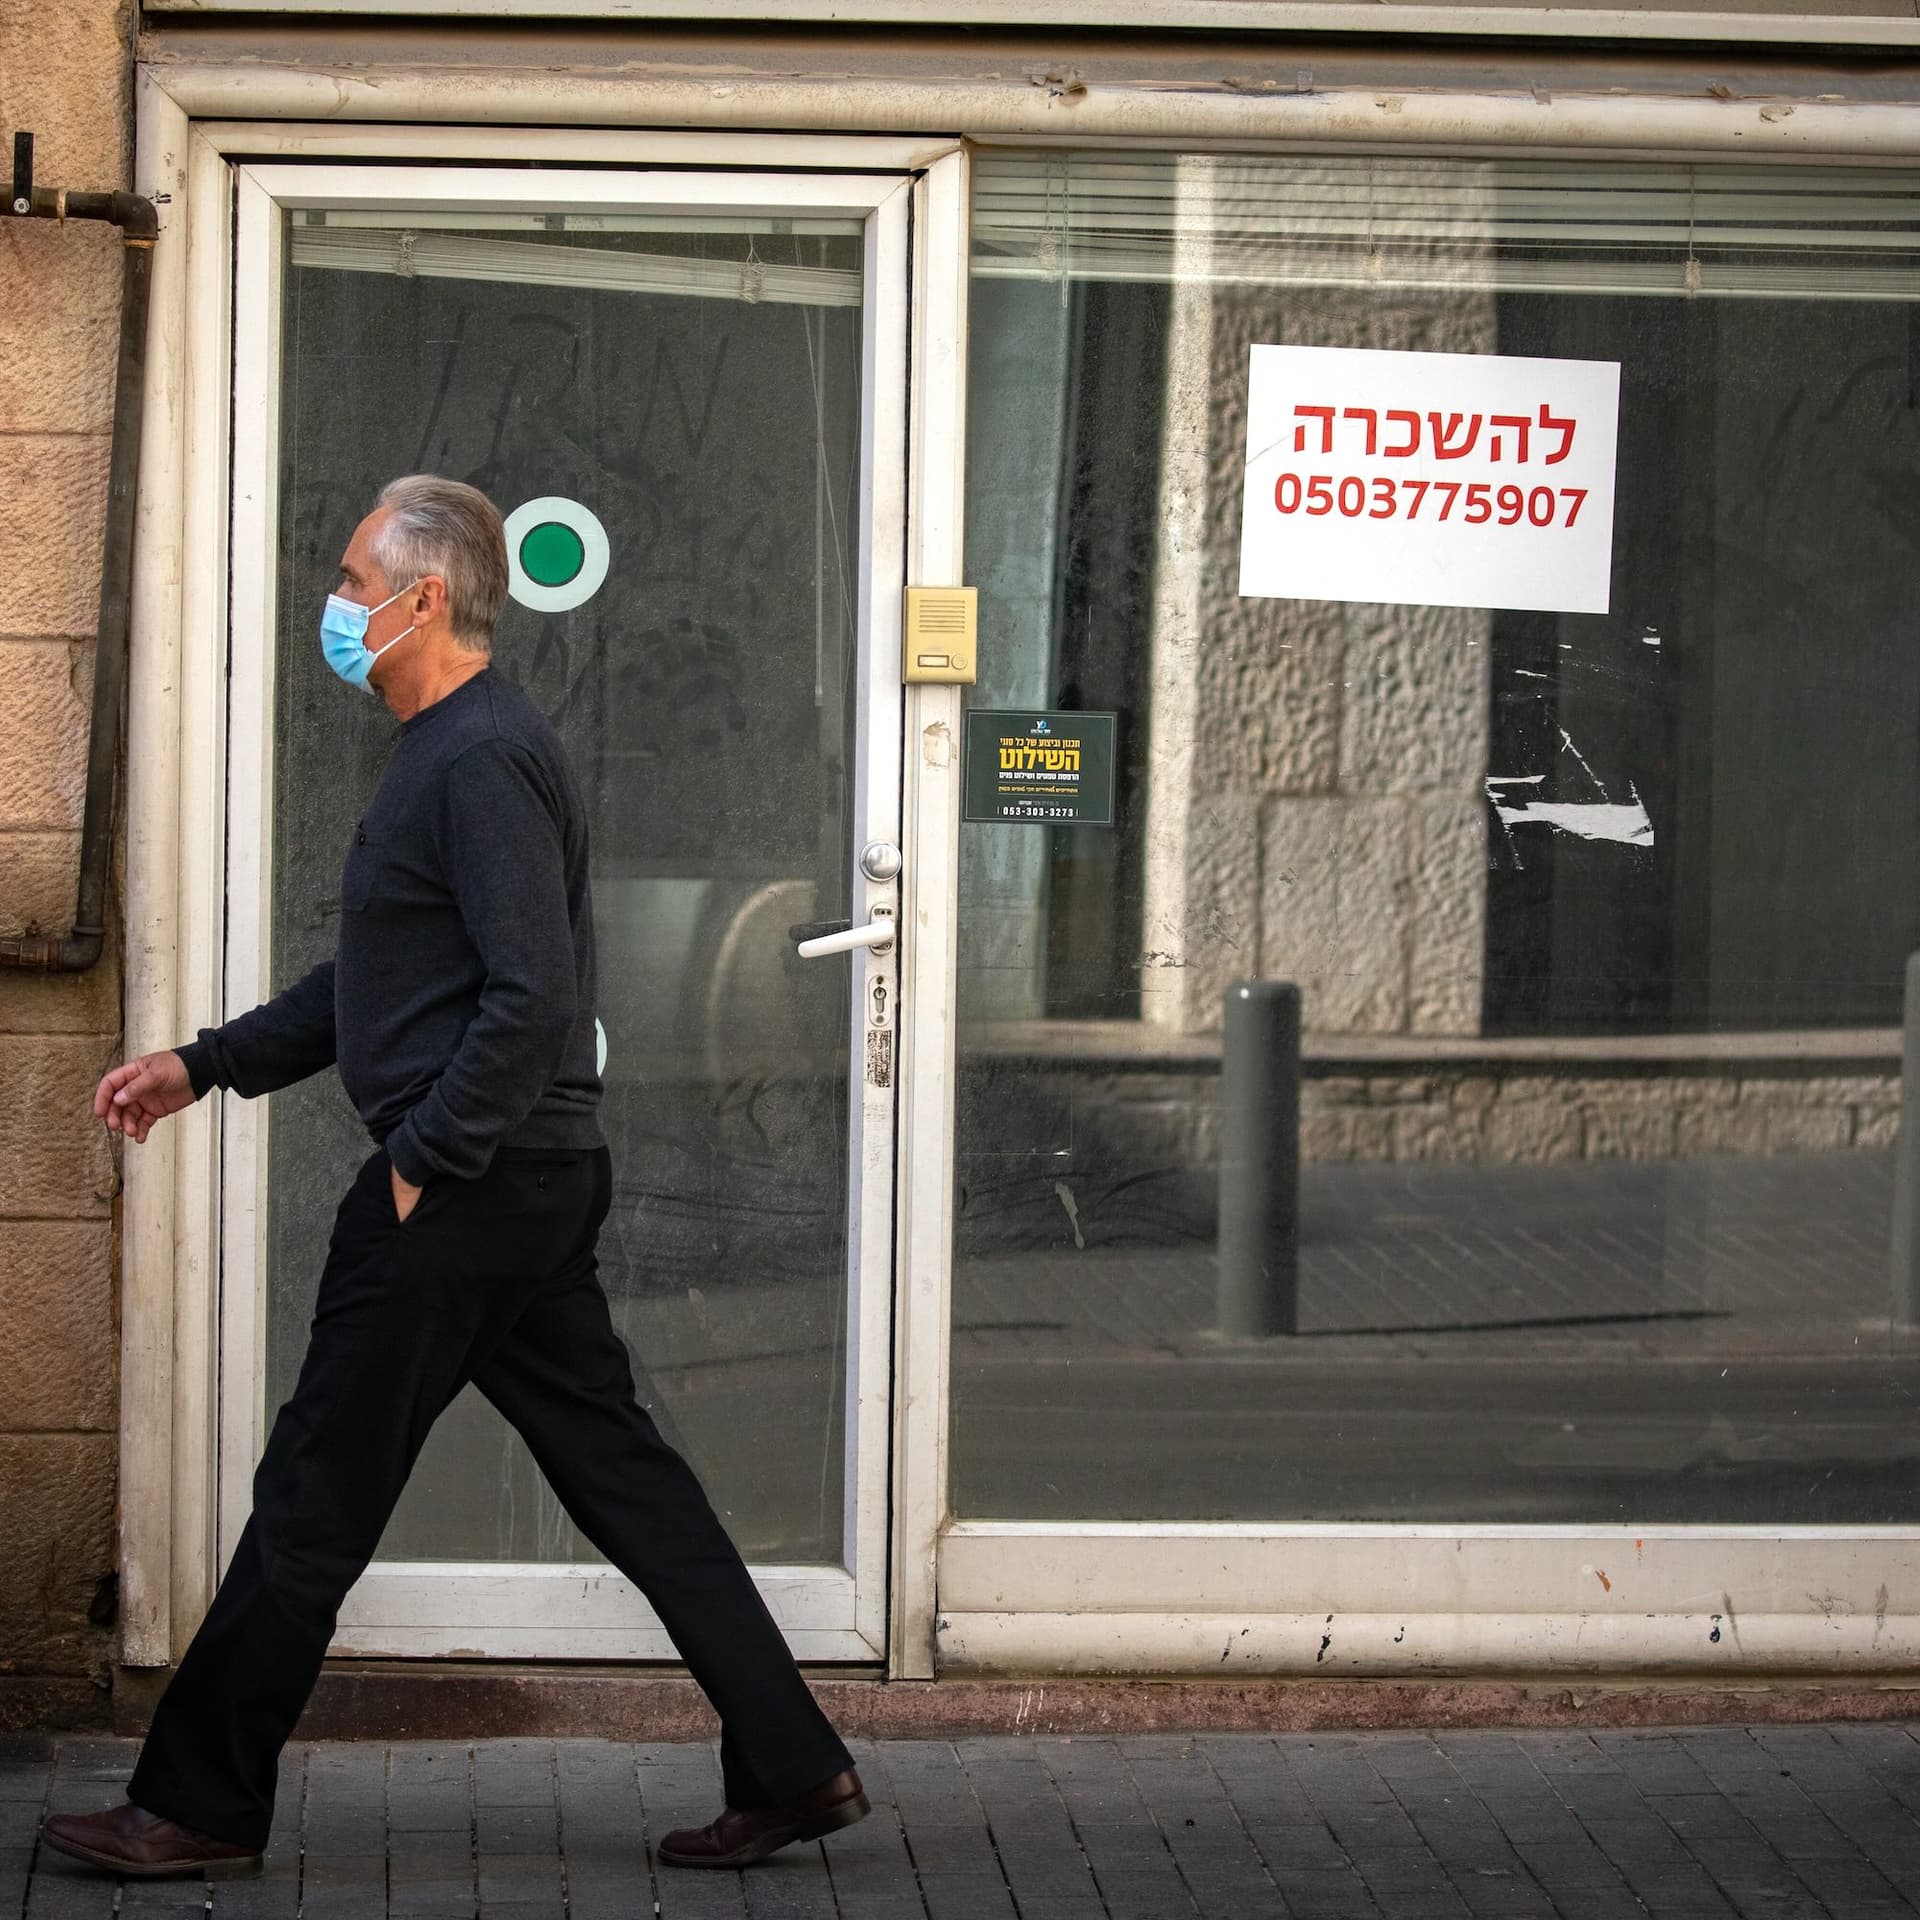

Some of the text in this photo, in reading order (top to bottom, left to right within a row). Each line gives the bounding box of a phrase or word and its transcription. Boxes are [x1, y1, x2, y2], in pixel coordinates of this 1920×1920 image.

[1293, 404, 1576, 465] להשכרה
[1274, 473, 1588, 528] 0503775907
[1015, 737, 1024, 746] כל
[1026, 737, 1038, 747] של
[1039, 738, 1061, 748] וביצוע
[1062, 739, 1080, 748] תכנון
[999, 746, 1080, 771] השילוט
[1003, 806, 1074, 817] 053-303-3273
